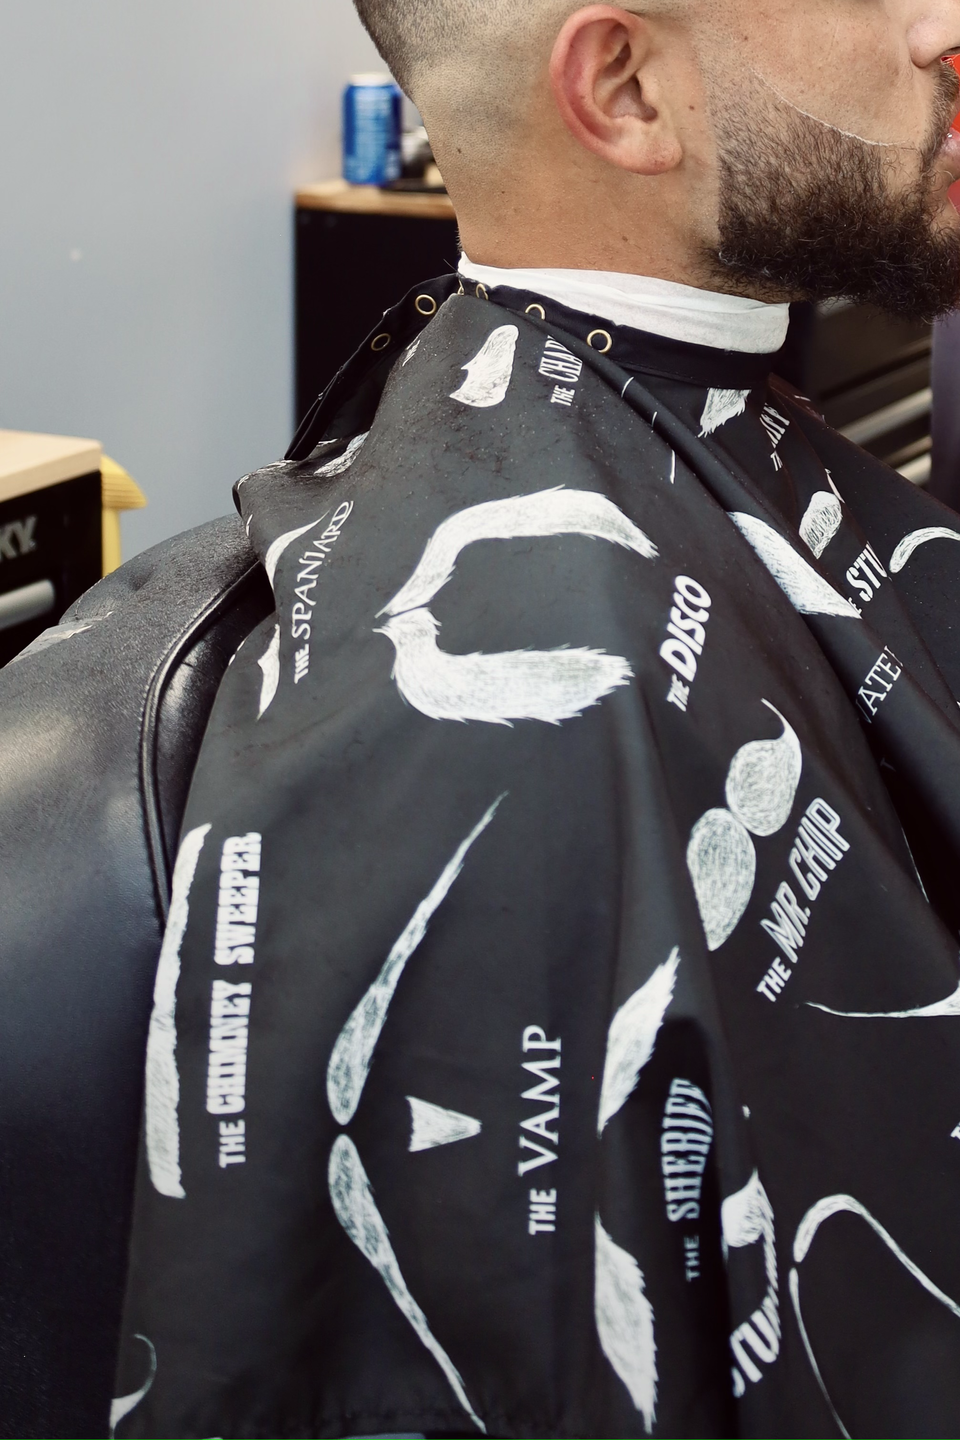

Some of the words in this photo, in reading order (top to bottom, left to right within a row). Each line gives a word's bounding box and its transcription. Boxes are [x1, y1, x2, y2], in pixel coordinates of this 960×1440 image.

[550, 384, 576, 407] THE
[291, 500, 354, 640] SPANIARD
[660, 575, 712, 682] DISCO
[294, 643, 310, 685] THE
[666, 673, 690, 712] THE
[788, 797, 850, 901] CHIP
[213, 831, 262, 965] SWEEPER
[760, 881, 811, 963] MR.
[756, 956, 792, 1002] THE
[206, 979, 252, 1114] CHIMNEY
[517, 1024, 561, 1176] VAMP
[219, 1119, 246, 1169] THE
[528, 1188, 557, 1235] THE
[684, 1236, 700, 1282] THE
